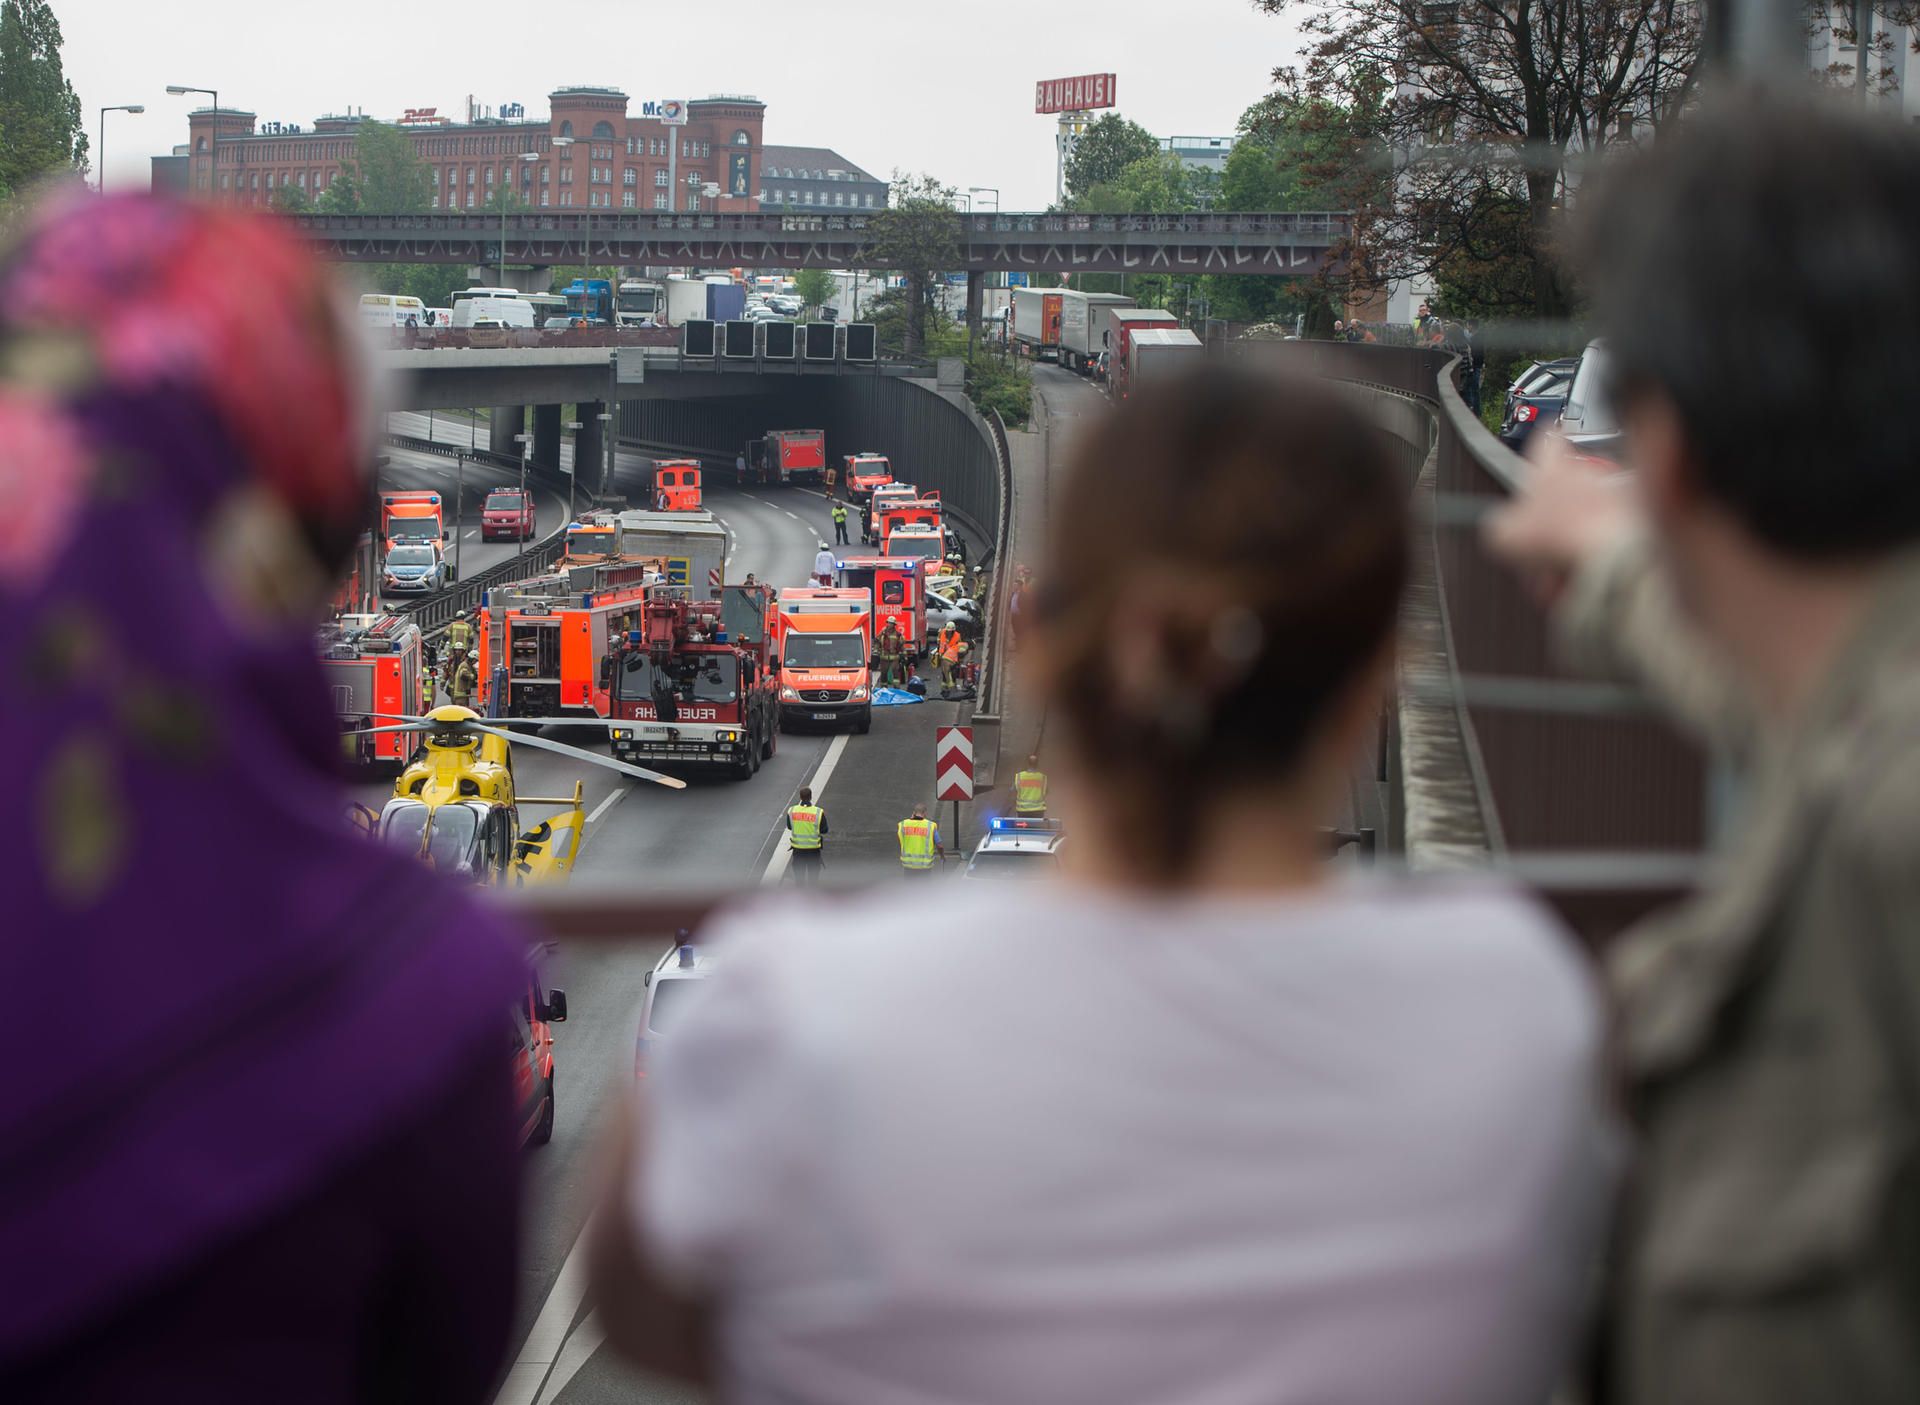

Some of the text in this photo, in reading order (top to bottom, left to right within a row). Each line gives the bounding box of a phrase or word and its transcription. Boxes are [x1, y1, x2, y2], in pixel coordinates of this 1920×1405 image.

[1036, 78, 1104, 109] BAUHAUS
[876, 604, 902, 615] WEHR
[797, 674, 851, 682] FEUERWEHR
